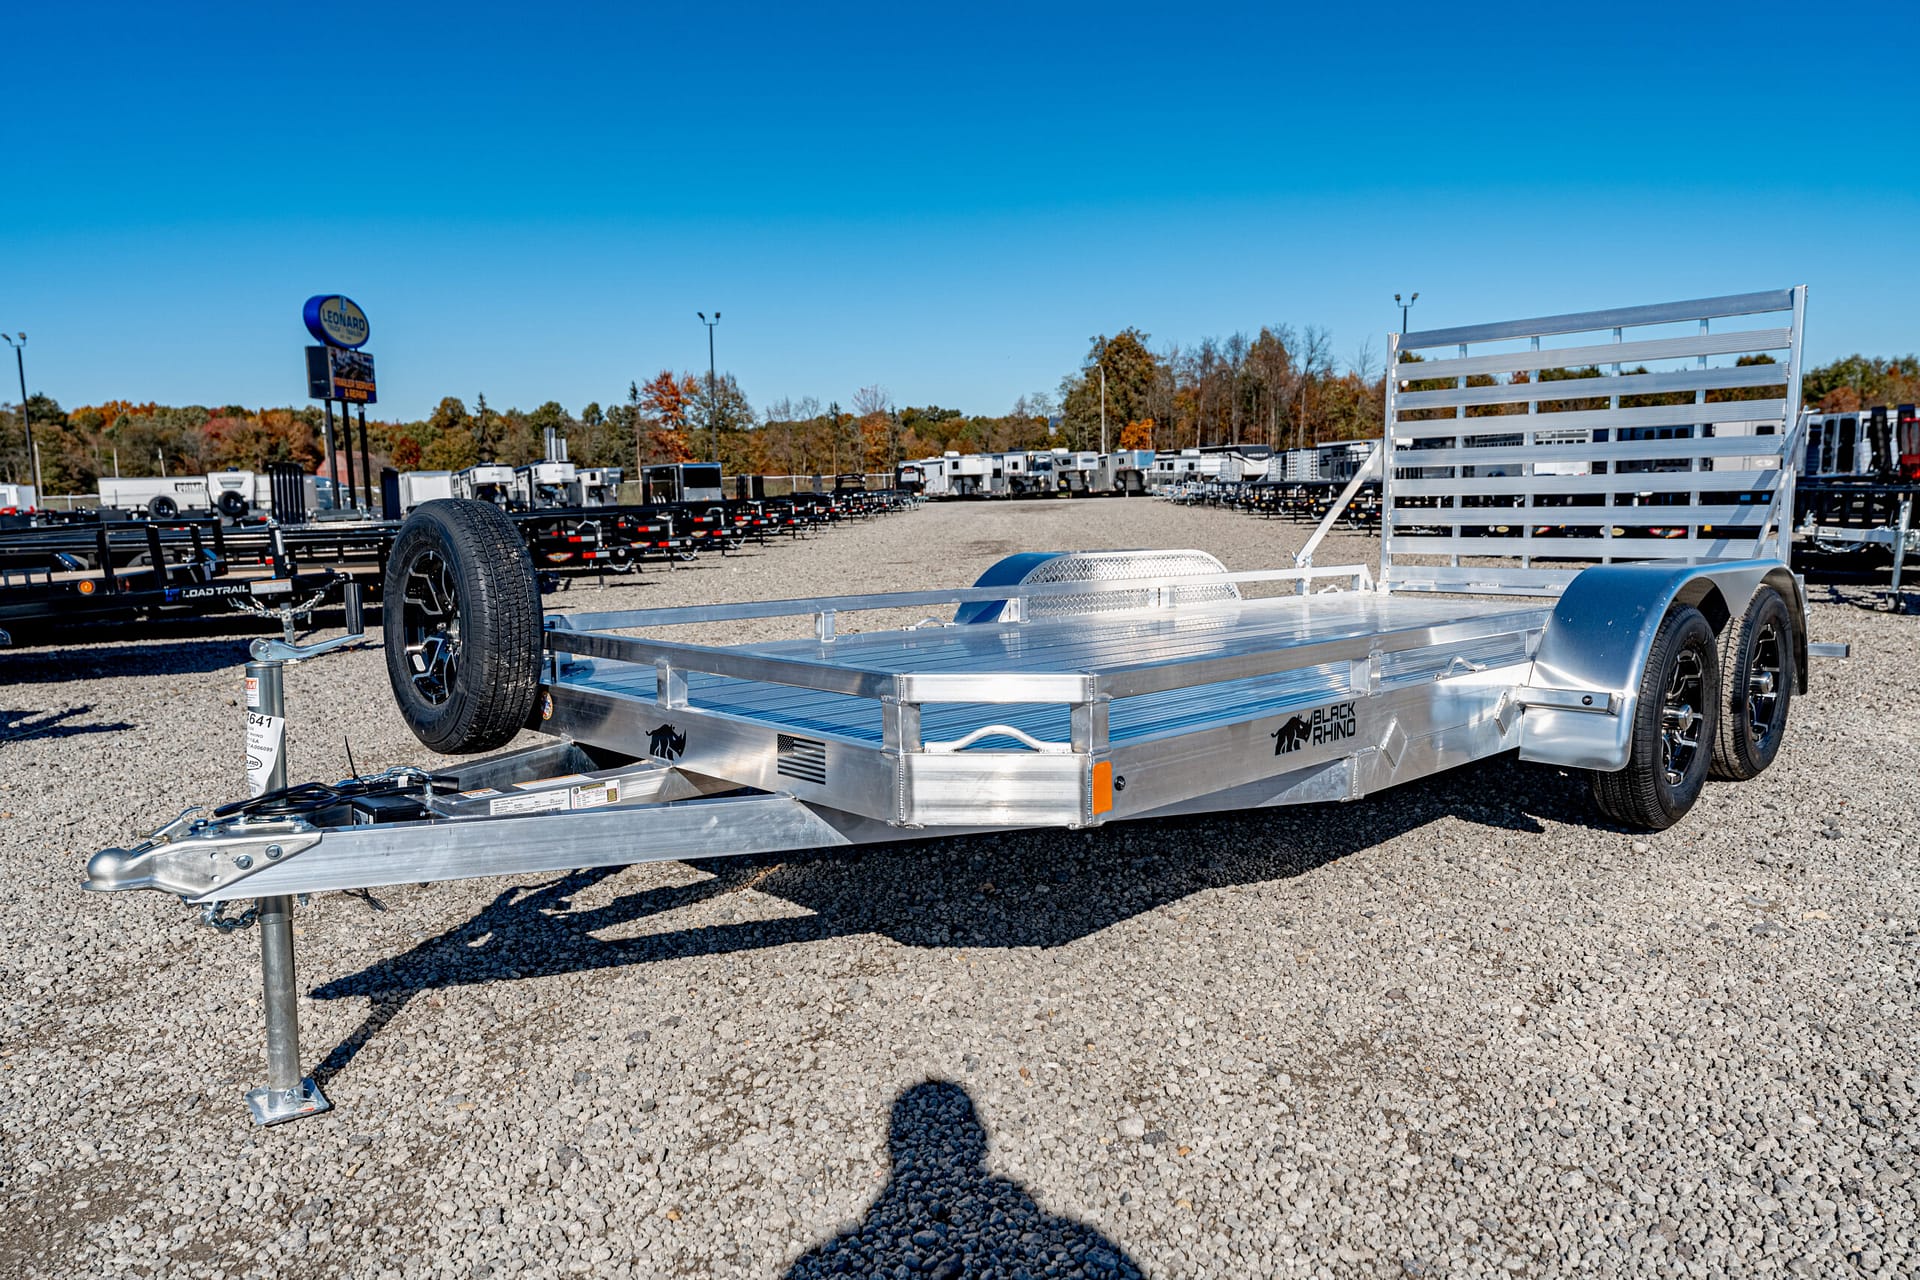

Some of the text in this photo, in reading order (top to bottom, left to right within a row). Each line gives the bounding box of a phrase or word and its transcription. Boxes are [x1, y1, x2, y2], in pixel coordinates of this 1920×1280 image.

[322, 308, 366, 331] LEONARD
[182, 588, 214, 598] LOAD
[215, 585, 249, 595] TRAIL
[247, 711, 273, 728] 641
[1313, 701, 1356, 726] BLACK
[1313, 718, 1356, 746] RHINO
